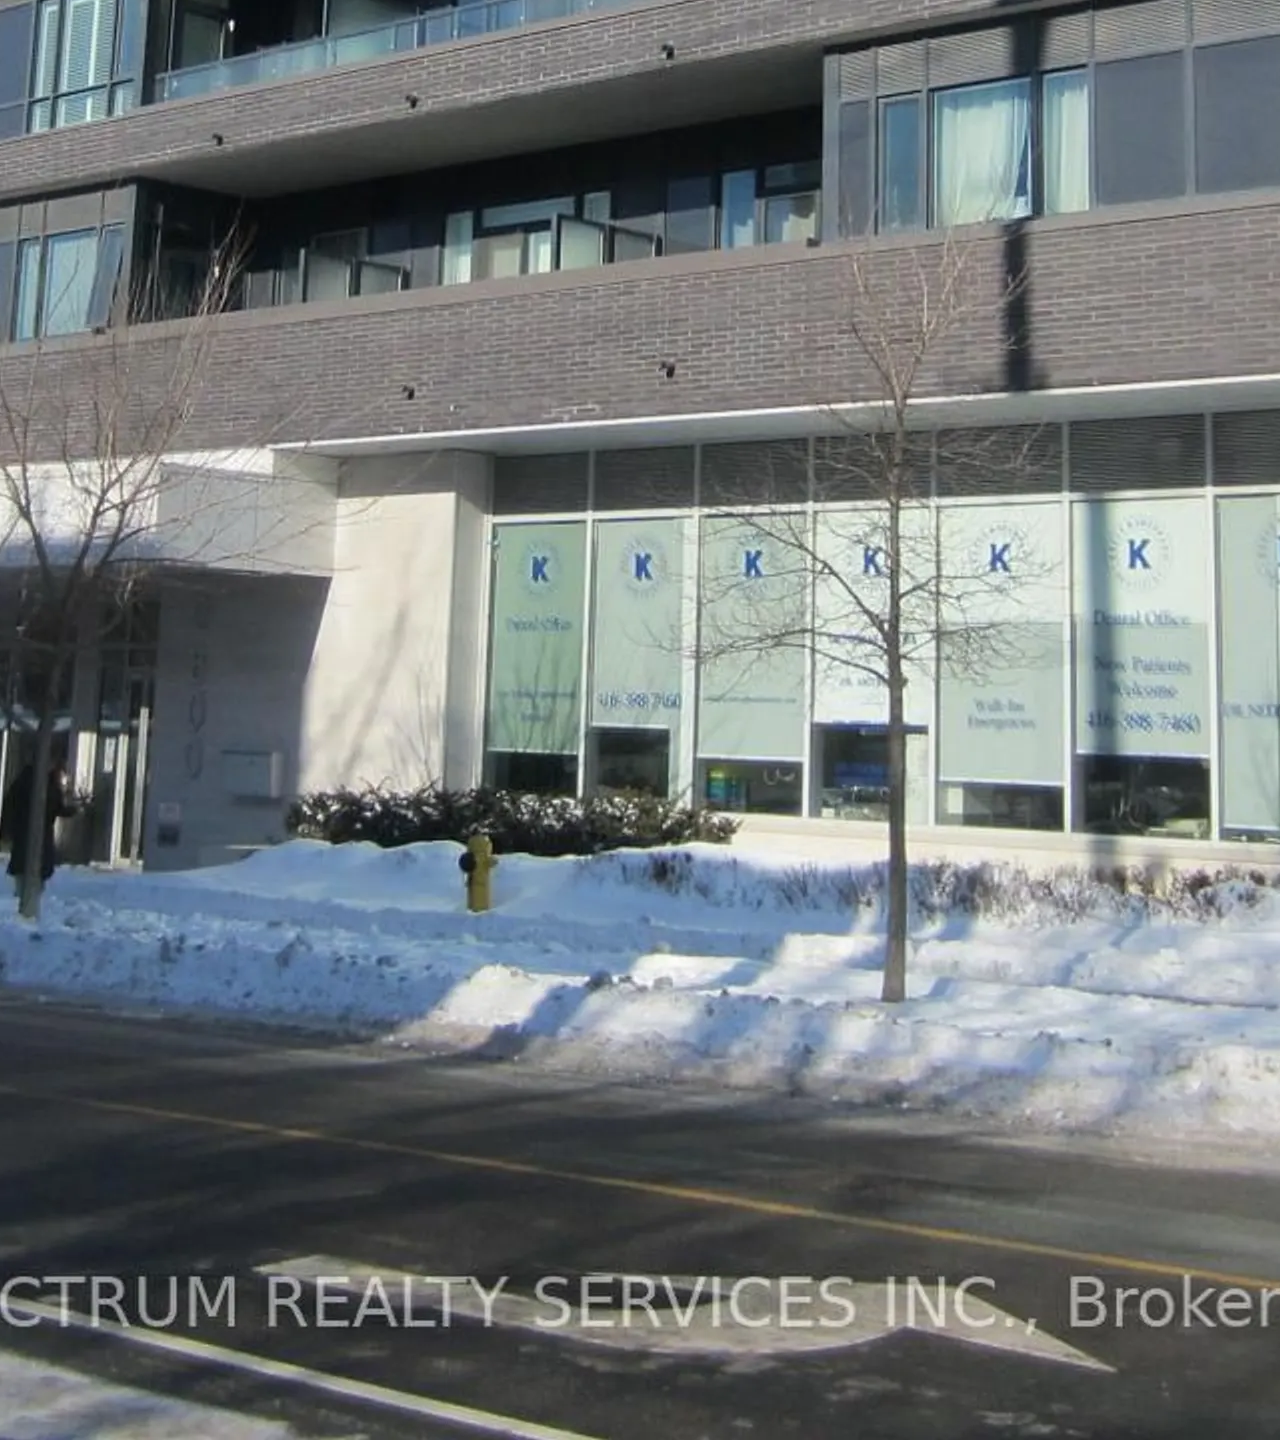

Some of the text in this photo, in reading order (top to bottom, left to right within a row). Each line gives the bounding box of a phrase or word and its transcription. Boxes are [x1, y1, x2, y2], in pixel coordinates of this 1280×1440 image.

[635, 553, 653, 581] K
[744, 549, 763, 578] K
[863, 546, 884, 575] K
[989, 543, 1011, 573] K
[1128, 538, 1151, 571] K
[532, 556, 549, 583] K
[1145, 611, 1191, 628] Office
